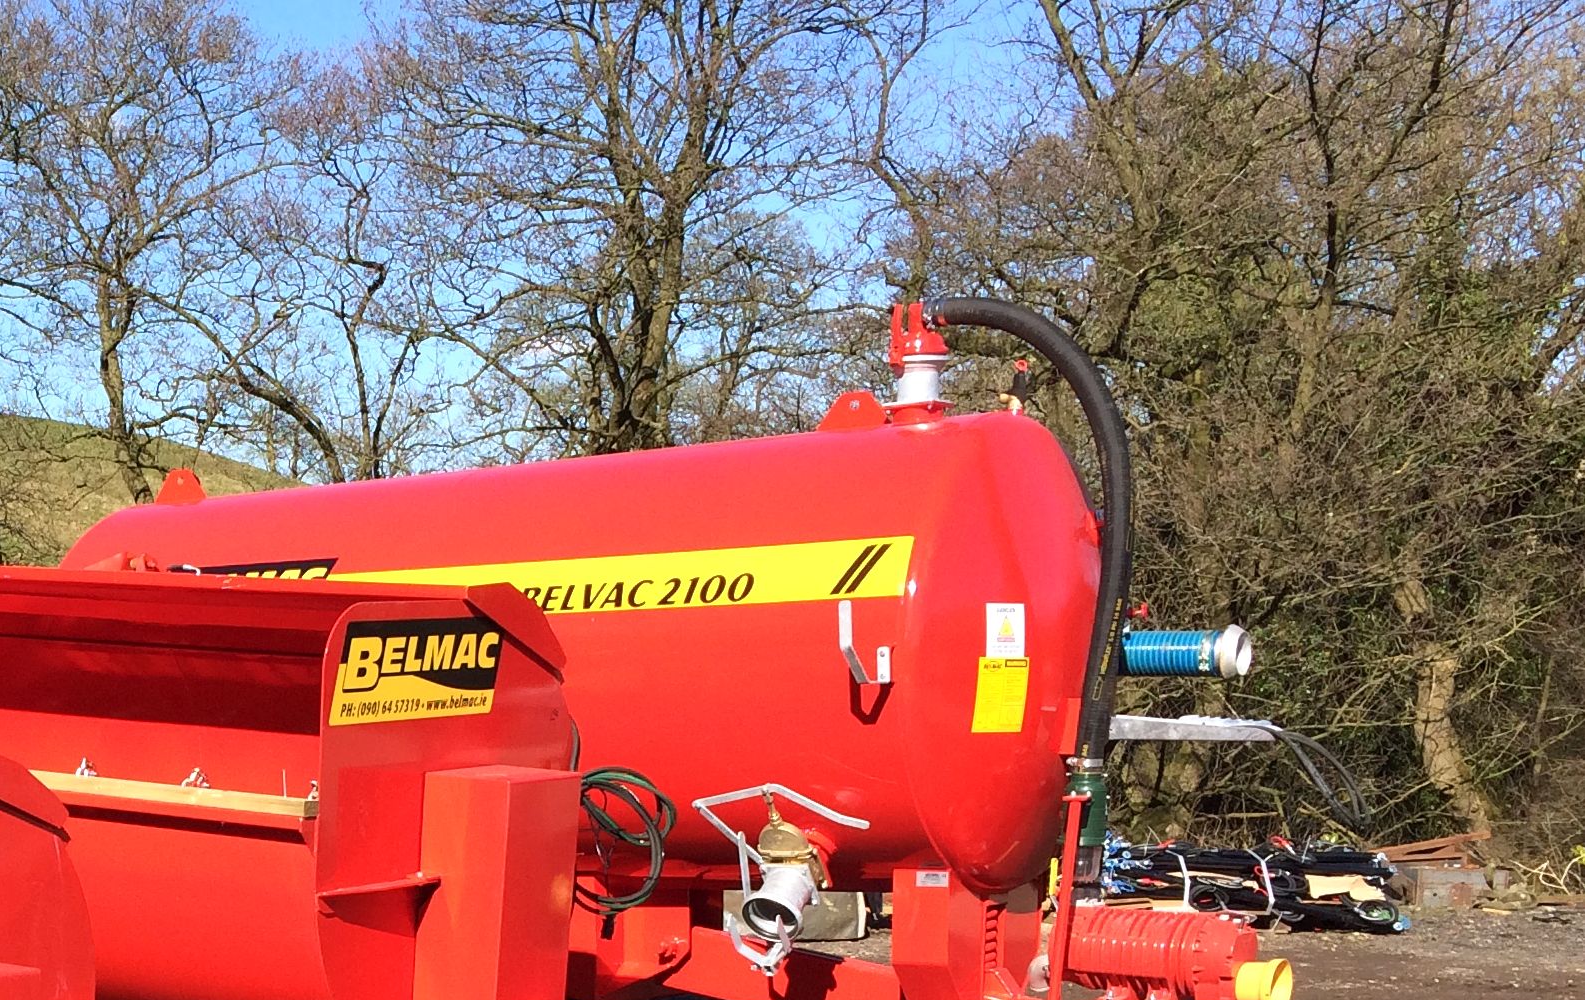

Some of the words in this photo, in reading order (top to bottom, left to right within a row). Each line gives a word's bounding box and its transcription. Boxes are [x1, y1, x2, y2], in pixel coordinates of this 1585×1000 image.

[657, 572, 755, 606] 2100
[342, 631, 500, 691] BELMAC
[340, 702, 356, 718] PH:
[357, 700, 380, 718] (090)
[426, 693, 487, 711] www.belmac.ie
